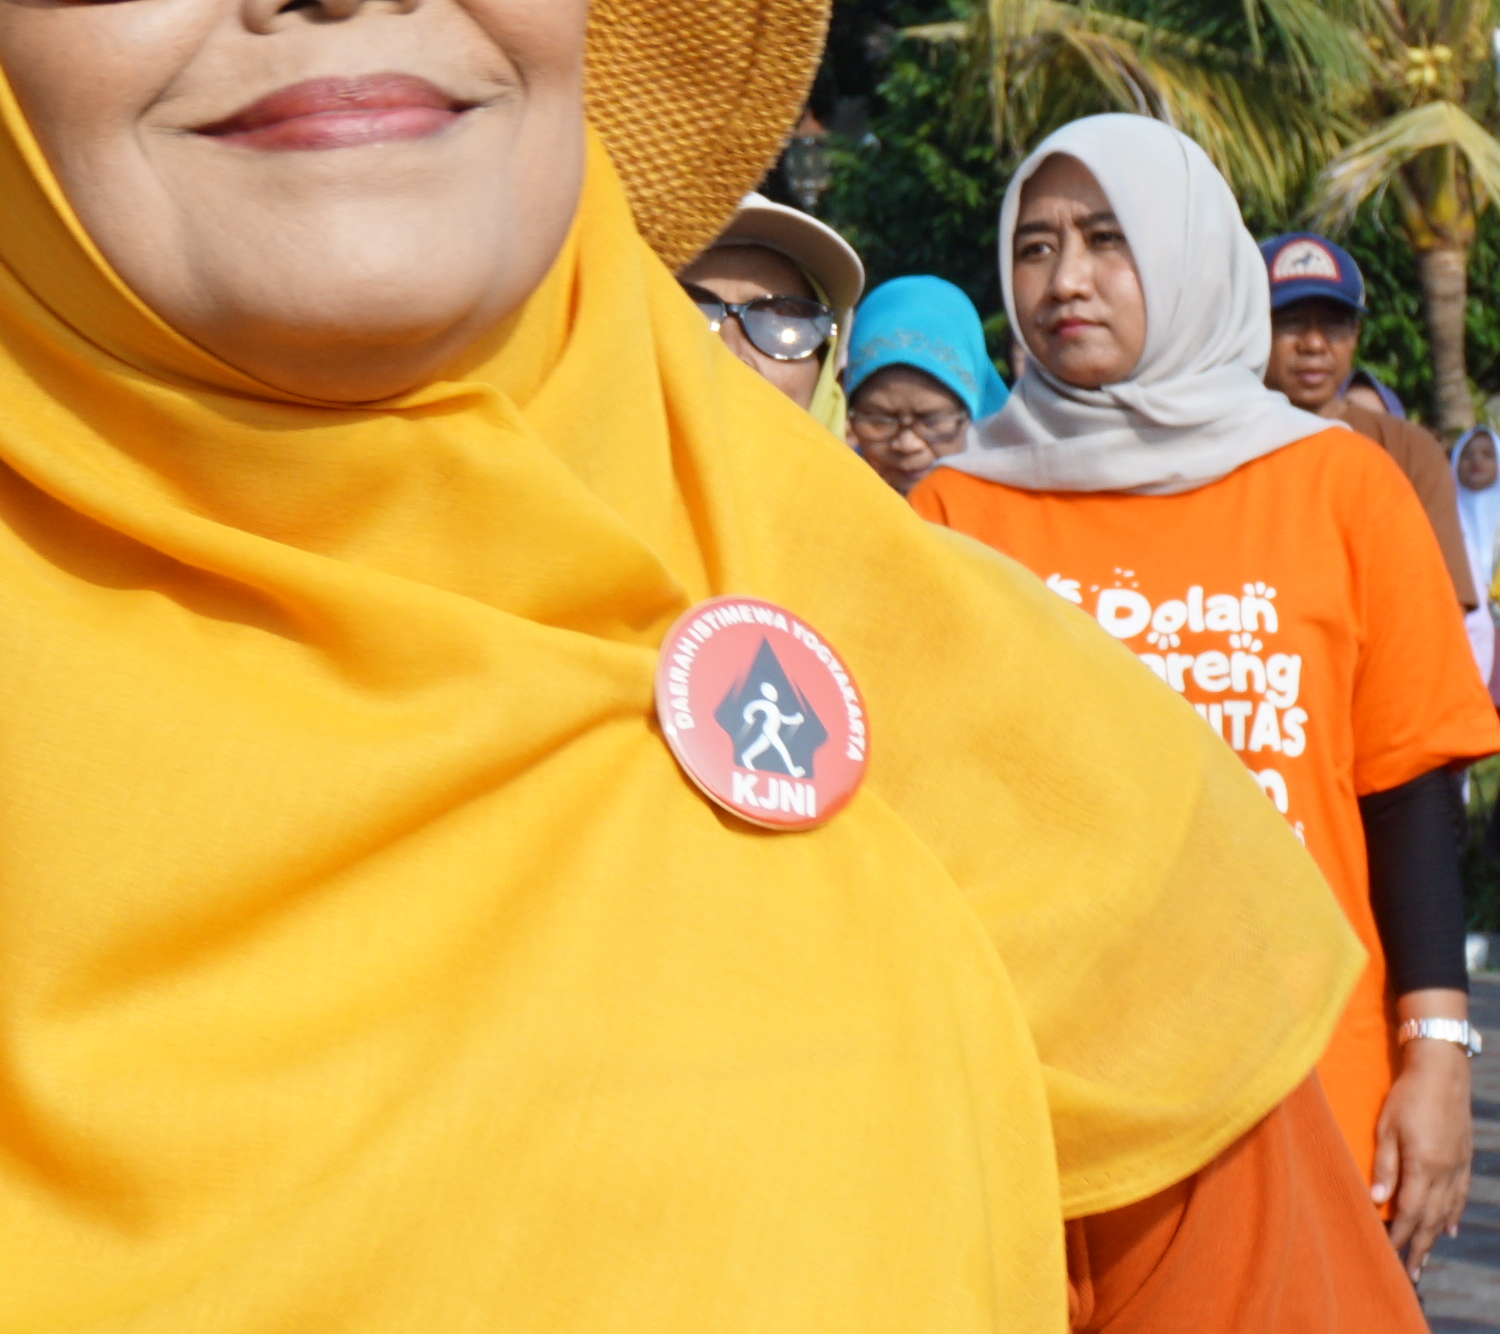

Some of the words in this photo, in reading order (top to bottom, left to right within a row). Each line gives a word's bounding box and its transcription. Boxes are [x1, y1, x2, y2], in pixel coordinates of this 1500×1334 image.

[1096, 584, 1278, 639] Dolan
[668, 635, 701, 730] DAERAH
[687, 603, 789, 644] ISTIMEWA
[792, 619, 866, 762] YOGYAKARTA
[731, 770, 817, 819] KJNI
